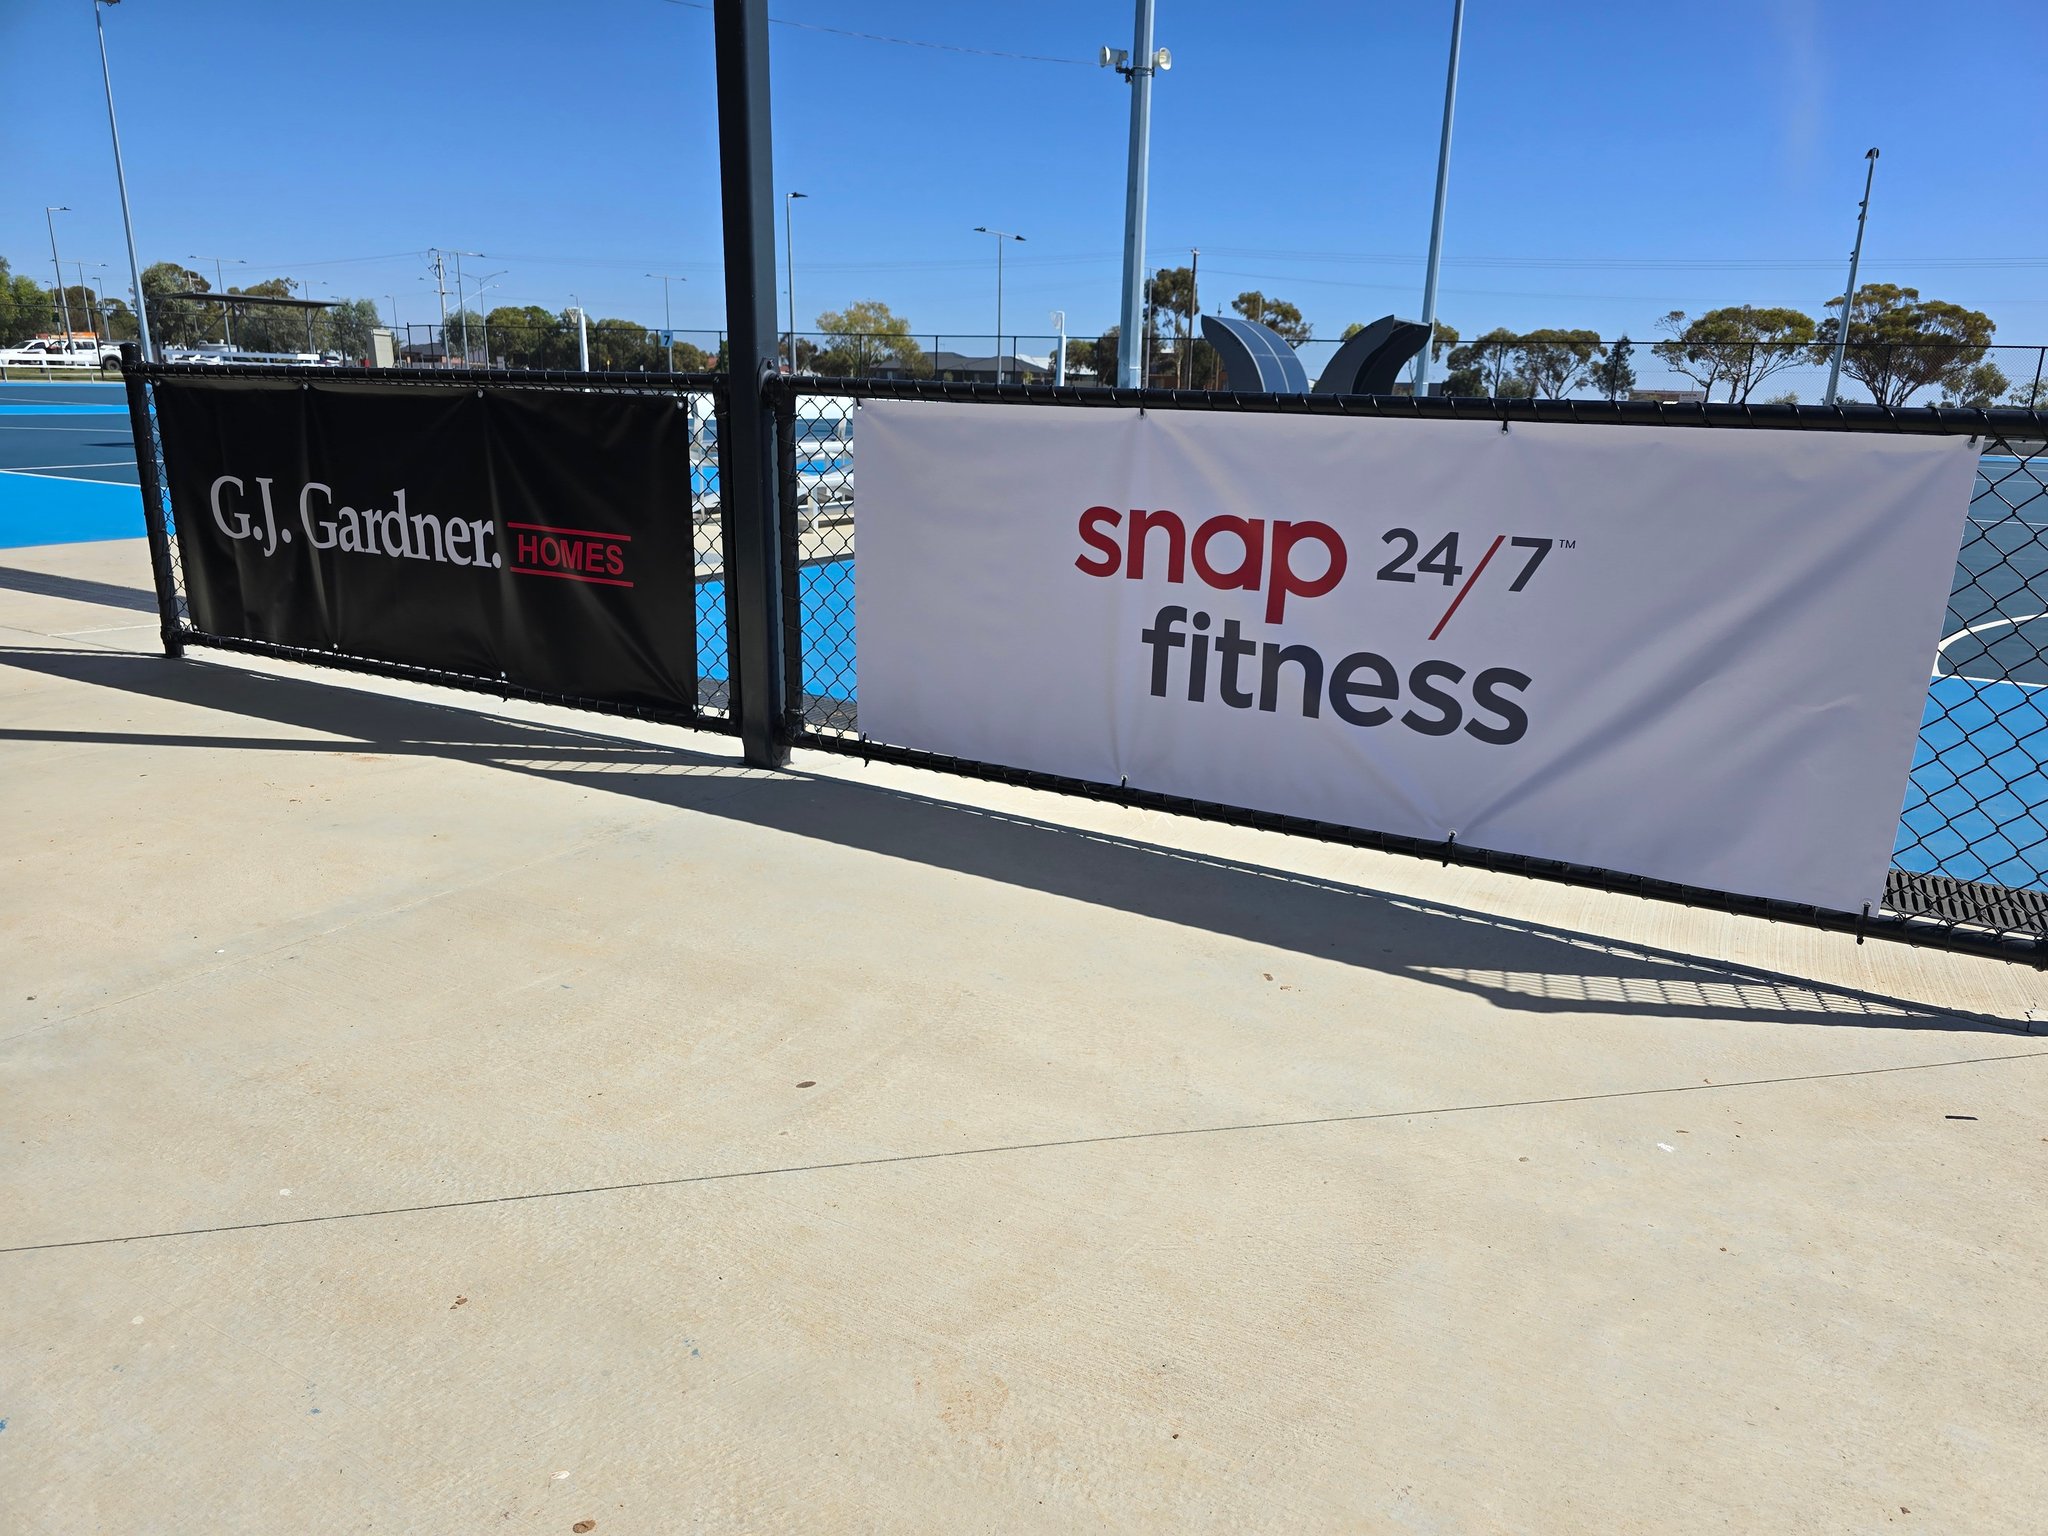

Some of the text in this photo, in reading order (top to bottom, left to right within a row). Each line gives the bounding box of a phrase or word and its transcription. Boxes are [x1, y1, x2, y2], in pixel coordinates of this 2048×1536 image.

[663, 334, 671, 346] 7
[210, 475, 292, 557] G.J.
[518, 534, 625, 575] HOMES
[1074, 505, 1348, 625] snap
[1141, 604, 1533, 746] fitness
